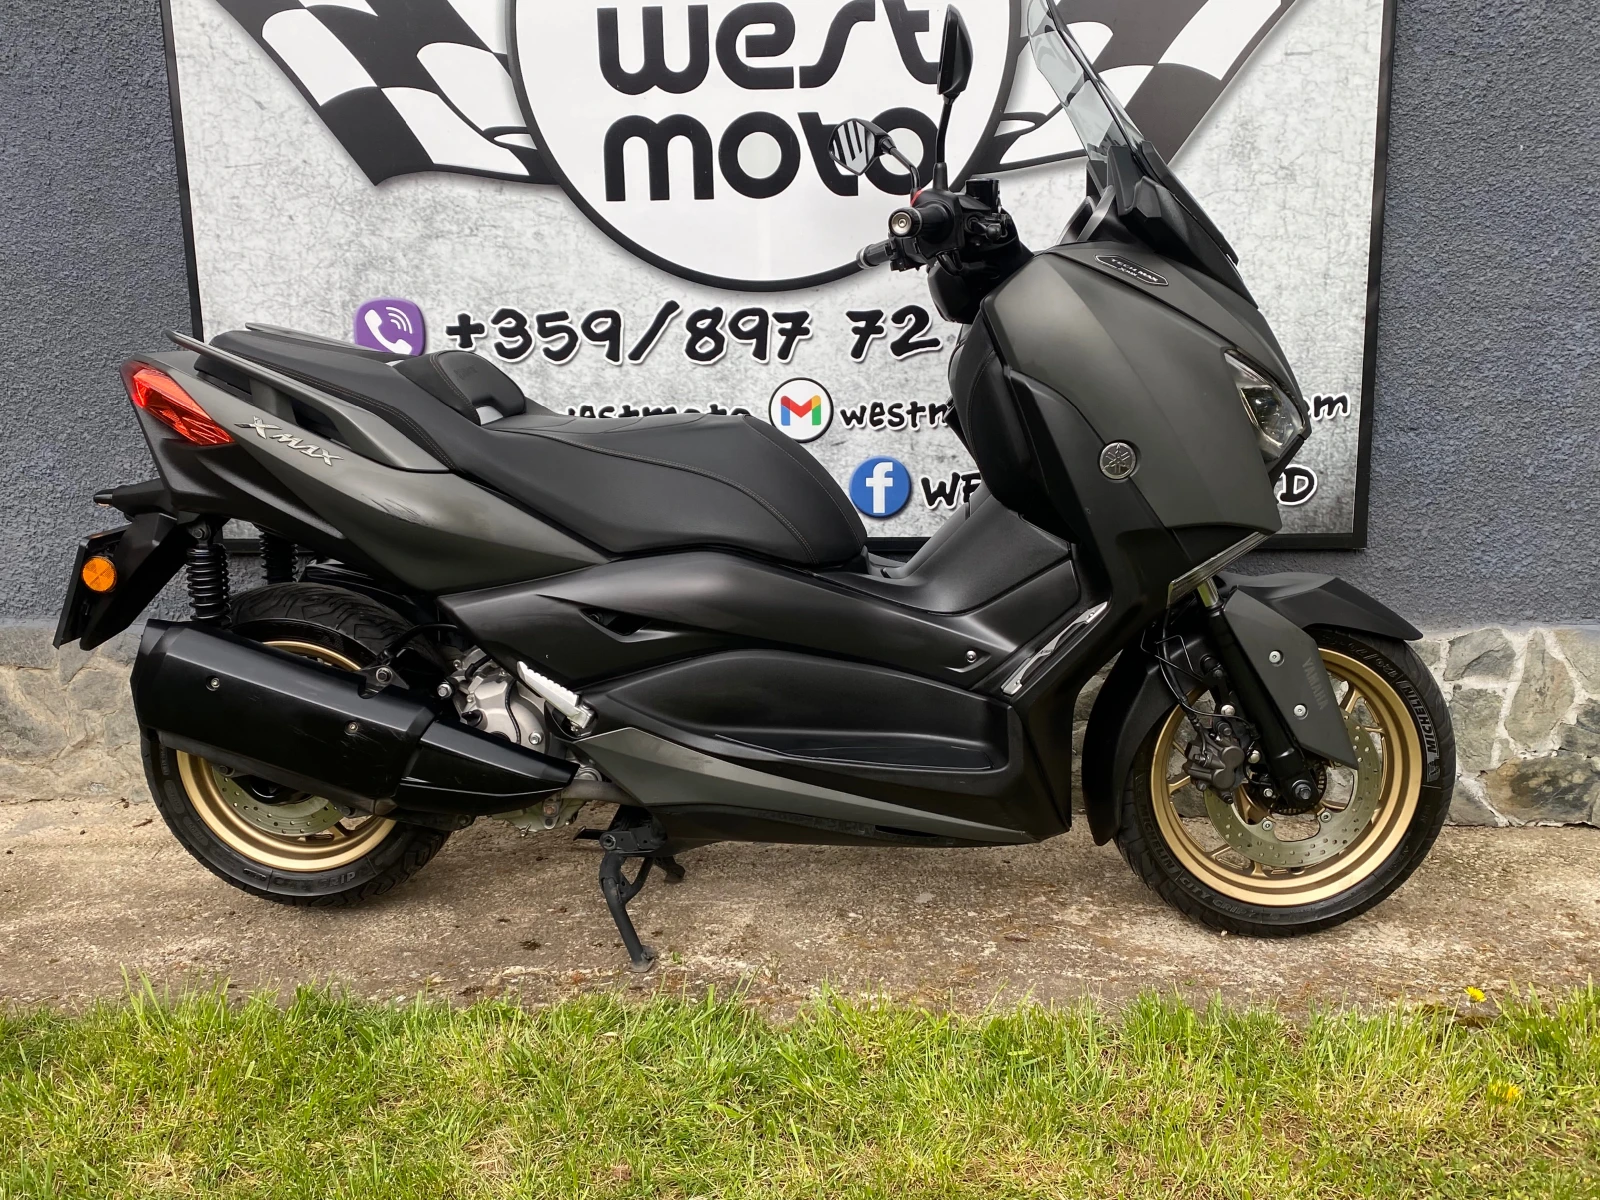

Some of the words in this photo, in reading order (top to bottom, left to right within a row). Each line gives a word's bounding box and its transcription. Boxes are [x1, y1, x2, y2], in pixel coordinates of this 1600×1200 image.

[597, 0, 939, 95] west
[604, 106, 938, 201] moto
[446, 300, 811, 362] +359/897
[846, 304, 941, 361] 72
[1304, 395, 1349, 418] m
[234, 415, 345, 467] XMAX
[1301, 656, 1330, 711] YAMAHA
[1401, 684, 1439, 756] MICHELIN
